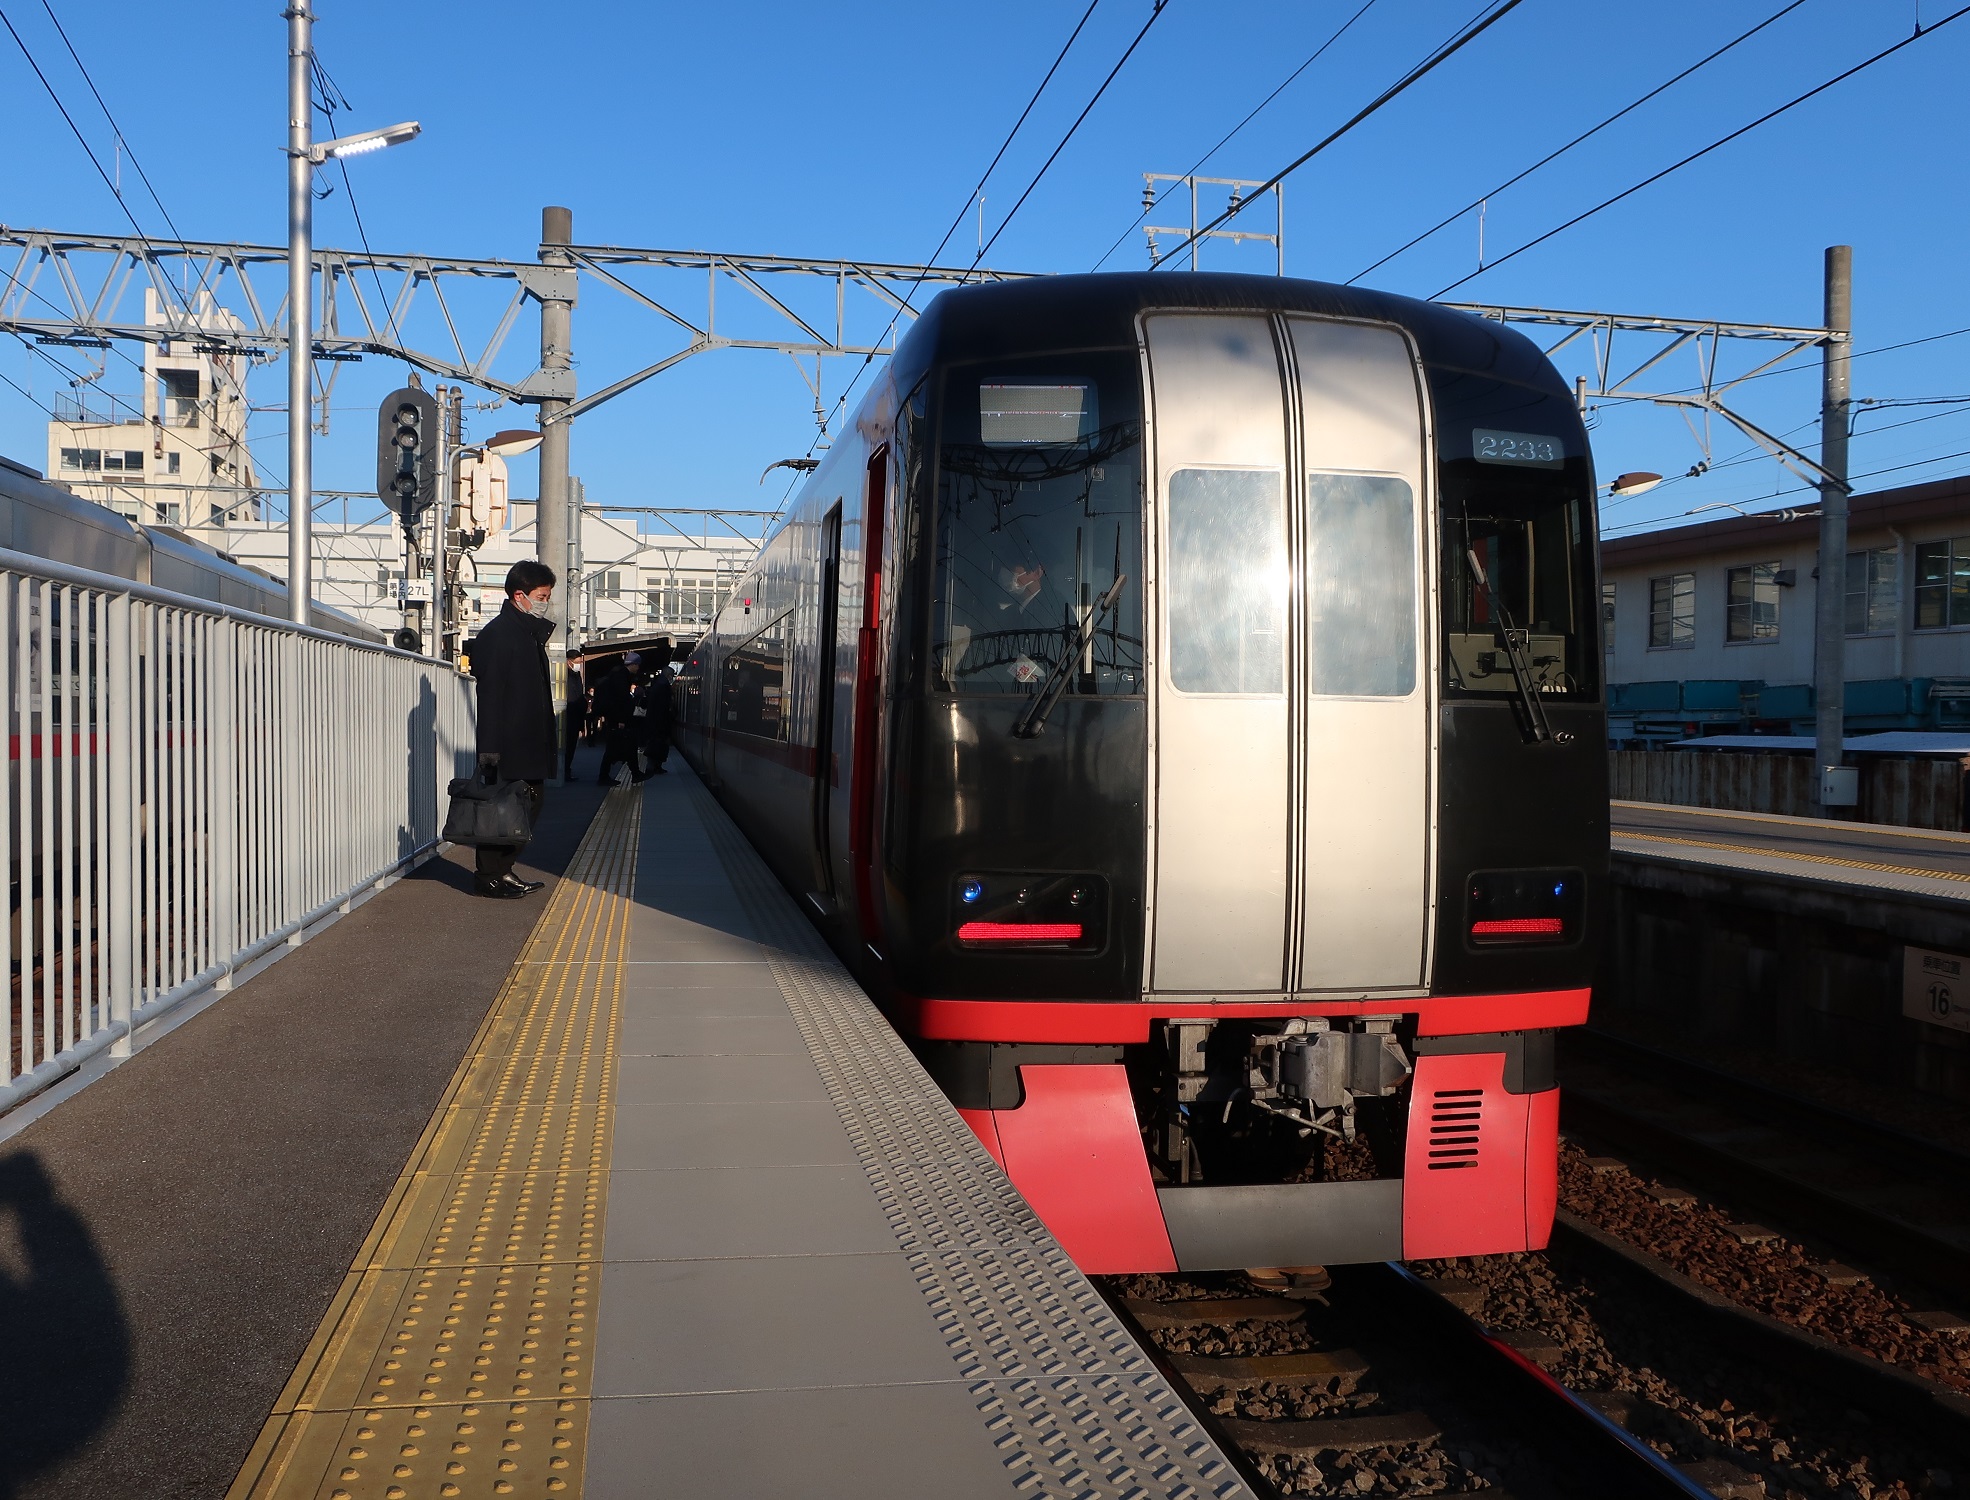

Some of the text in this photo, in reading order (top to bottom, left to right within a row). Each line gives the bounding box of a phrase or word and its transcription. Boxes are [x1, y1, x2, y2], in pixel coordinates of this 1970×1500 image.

[1480, 436, 1554, 461] 2233
[407, 585, 429, 596] 27L
[1922, 955, 1961, 975] 乗車位置
[1929, 986, 1950, 1015] 16
